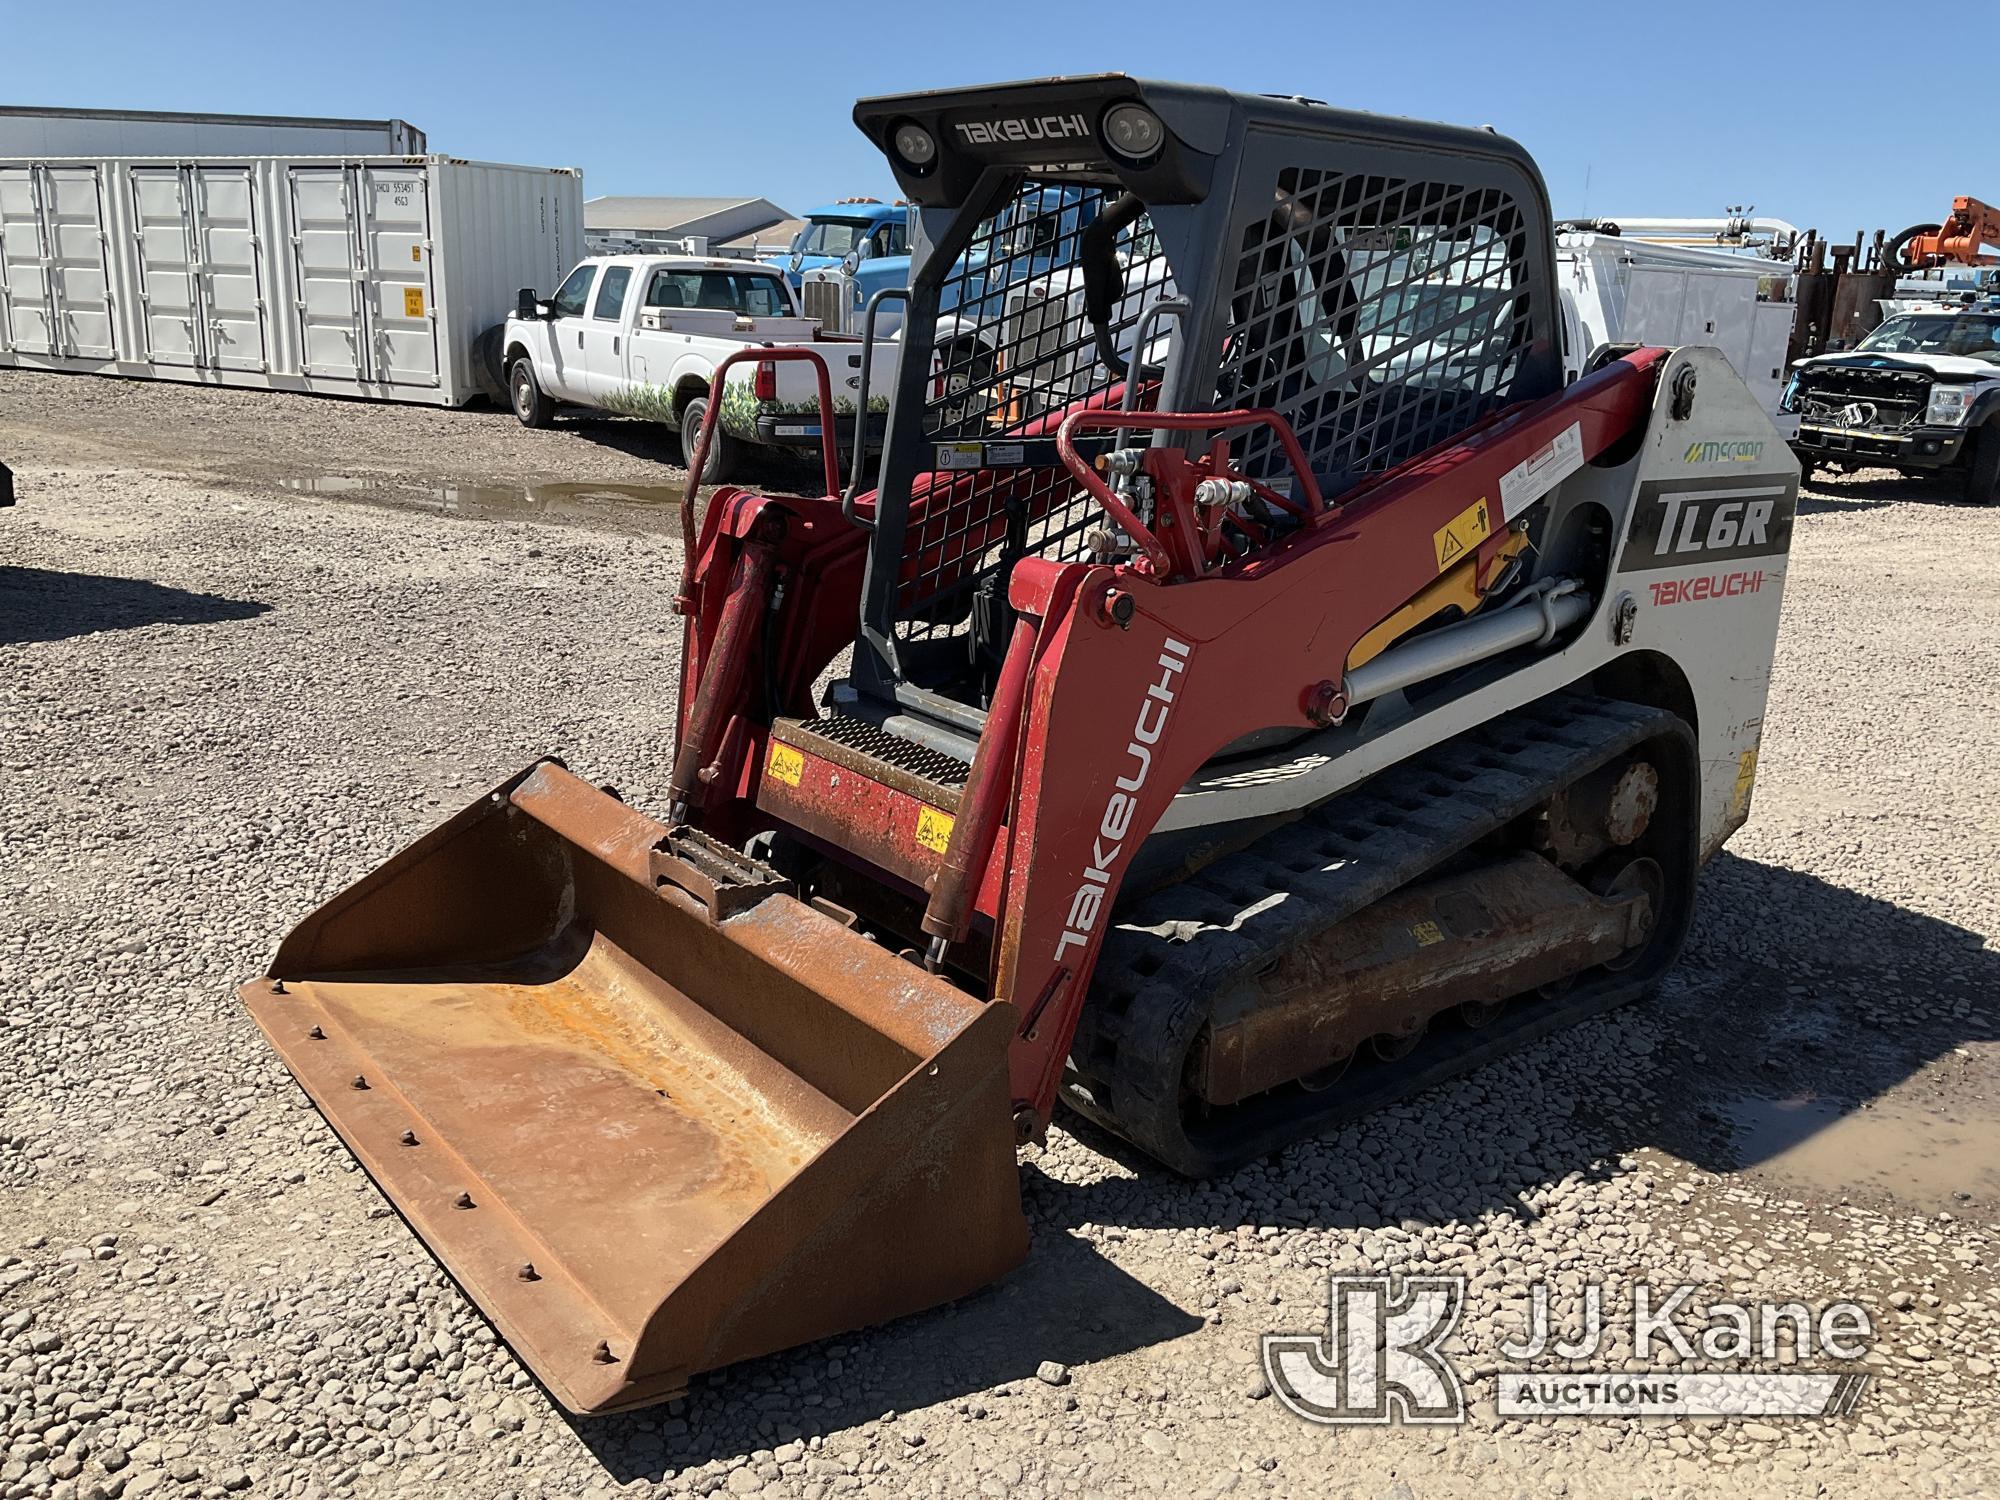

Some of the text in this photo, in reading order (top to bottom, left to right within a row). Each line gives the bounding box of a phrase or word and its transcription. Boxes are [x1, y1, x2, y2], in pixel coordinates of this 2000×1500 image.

[955, 114, 1090, 144] TAKEUCHI
[393, 183, 415, 193] 553451
[1653, 486, 1787, 556] TL6R
[1649, 570, 1764, 607] TAKEUCHI
[1053, 637, 1192, 962] TAKEUCHI
